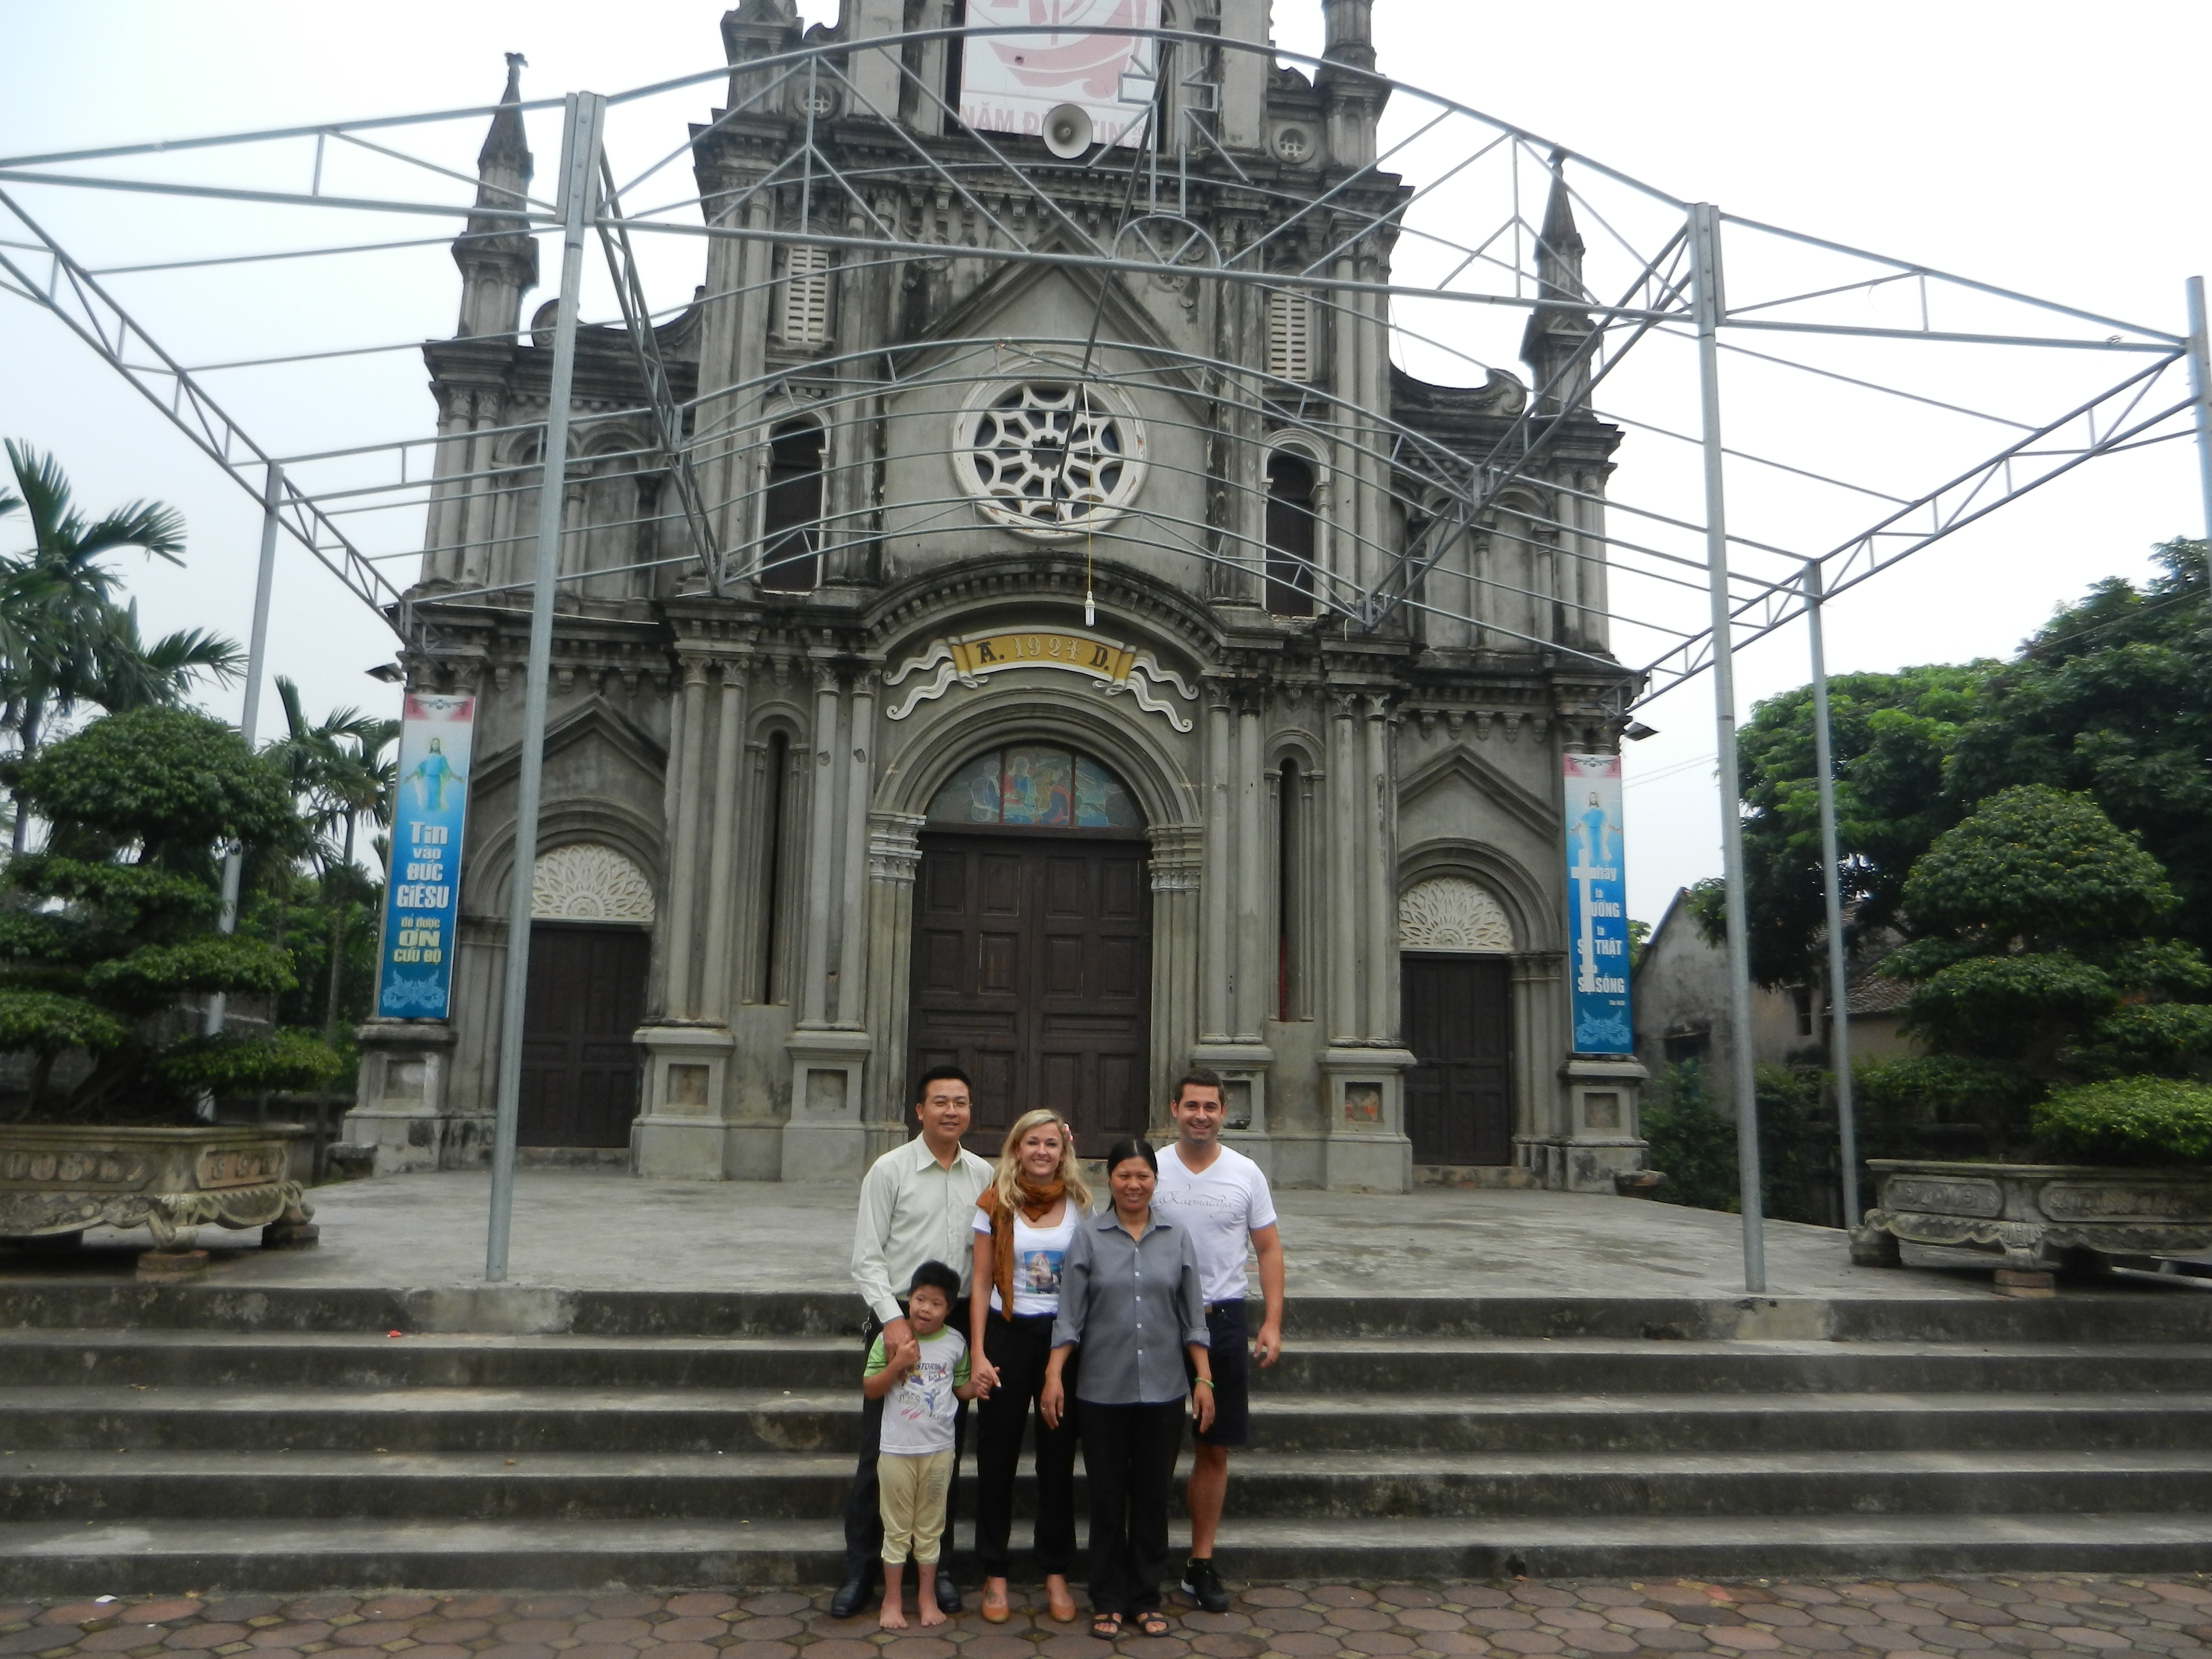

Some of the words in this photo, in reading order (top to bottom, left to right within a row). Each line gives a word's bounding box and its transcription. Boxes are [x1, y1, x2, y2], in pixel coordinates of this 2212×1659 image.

[1013, 635, 1081, 661] 1924
[410, 821, 448, 845] Tin
[1585, 899, 1620, 918] ƯỜNG
